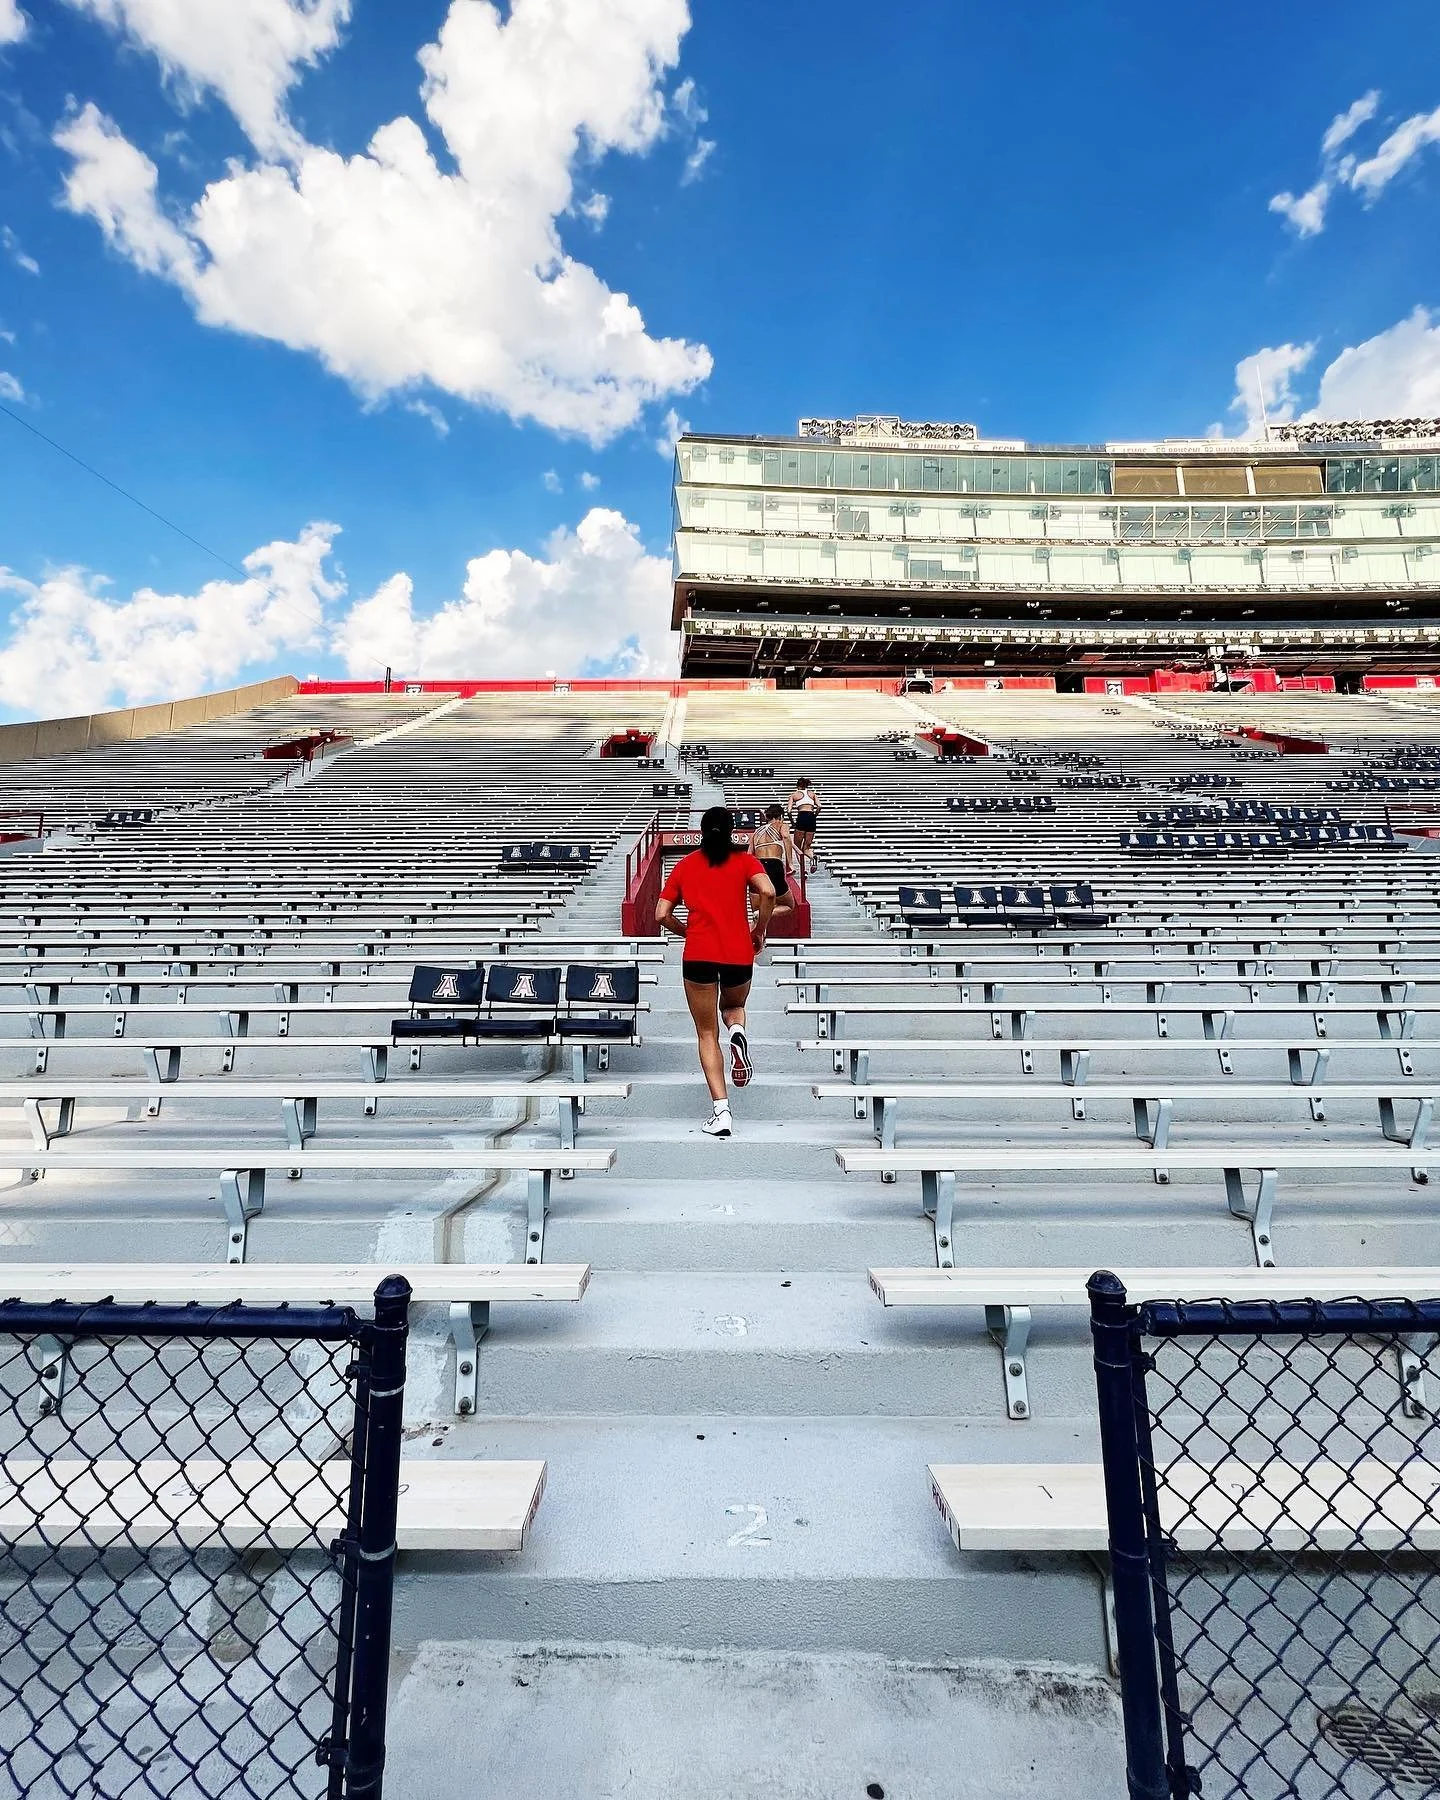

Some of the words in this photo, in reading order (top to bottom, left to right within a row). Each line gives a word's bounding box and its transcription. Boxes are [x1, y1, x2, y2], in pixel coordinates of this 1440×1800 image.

[1108, 685, 1122, 695] 21
[682, 834, 692, 845] 18
[432, 973, 461, 999] A
[509, 973, 537, 999] A
[589, 973, 617, 999] A
[725, 1503, 772, 1547] 2
